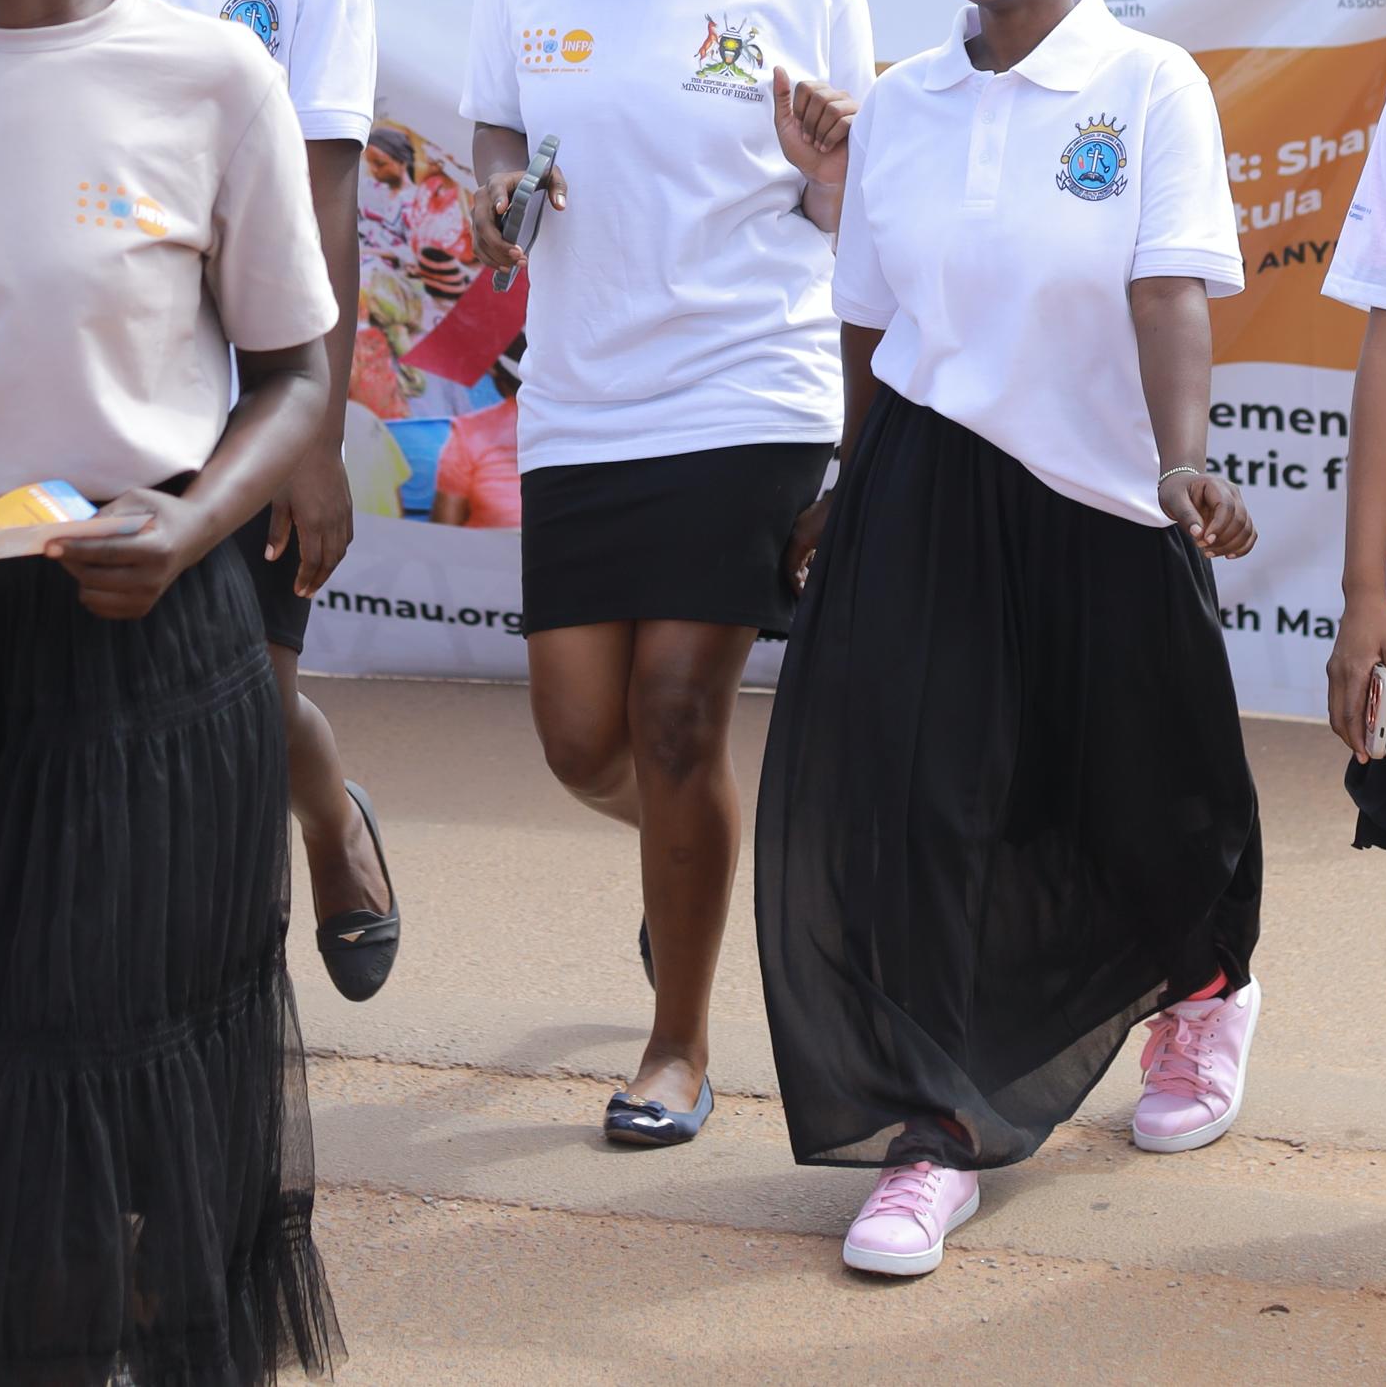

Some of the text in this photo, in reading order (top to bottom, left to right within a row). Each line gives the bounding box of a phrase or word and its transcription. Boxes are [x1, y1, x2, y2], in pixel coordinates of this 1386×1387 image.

[681, 82, 765, 102] MINISTRY OF HEALTH
[1256, 240, 1338, 274] ANY
[1277, 606, 1341, 640] Ma
